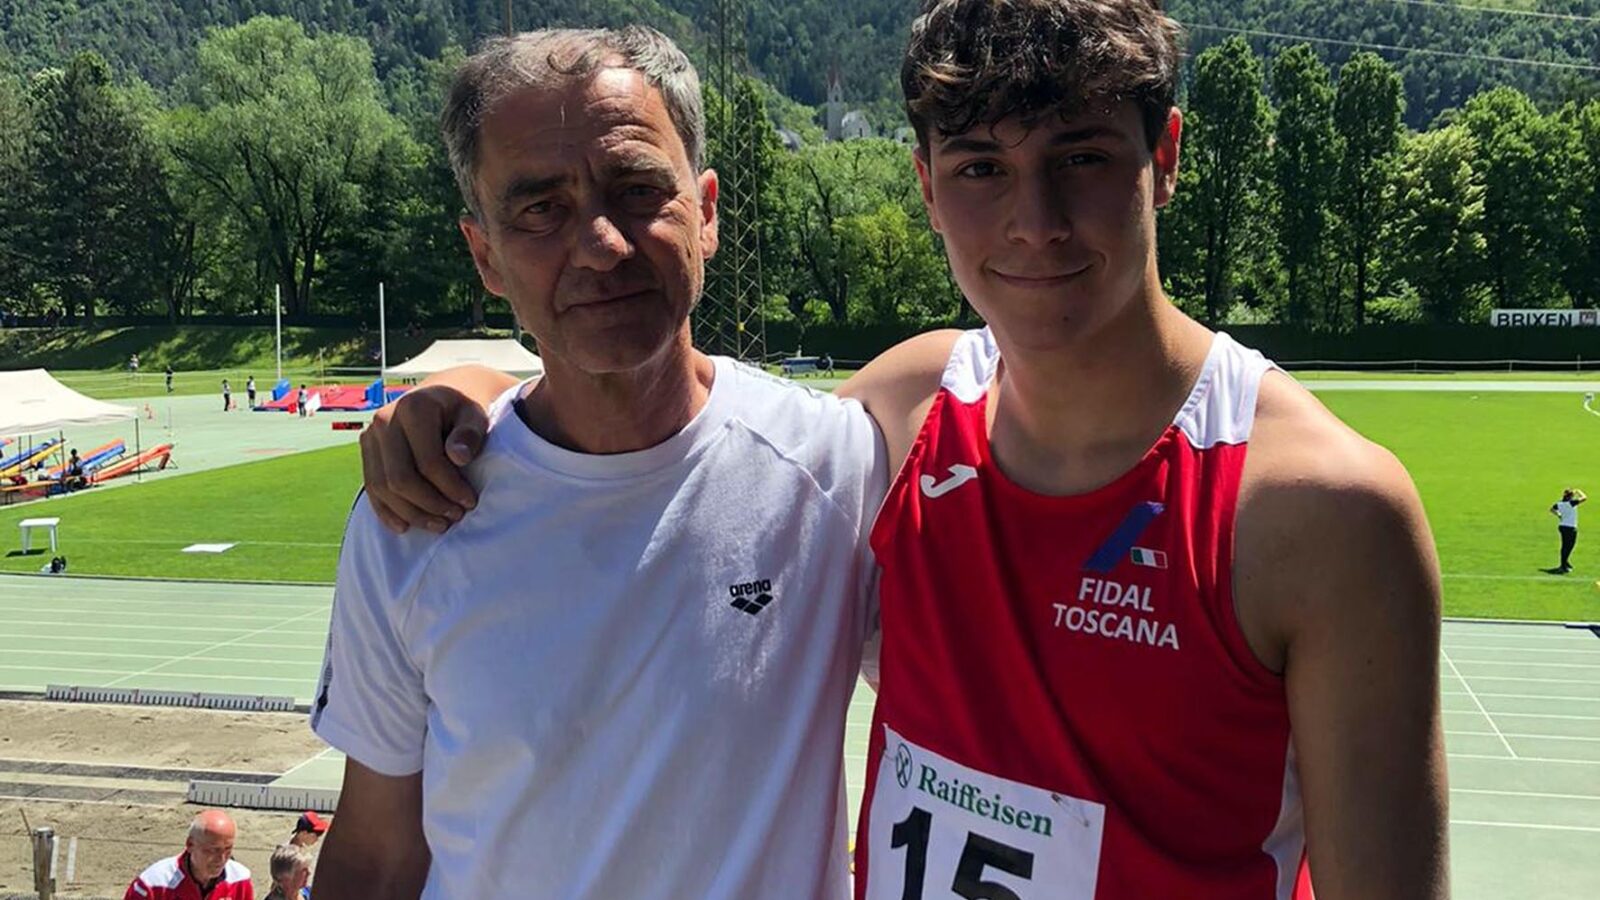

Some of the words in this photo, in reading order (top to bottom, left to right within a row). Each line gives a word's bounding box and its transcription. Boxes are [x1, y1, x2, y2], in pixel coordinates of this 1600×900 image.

[1497, 313, 1572, 326] BRIXEN
[729, 579, 771, 597] arena
[1078, 577, 1155, 612] FIDAL
[1052, 603, 1180, 650] TOSCANA
[917, 763, 1053, 837] Raiffeisen
